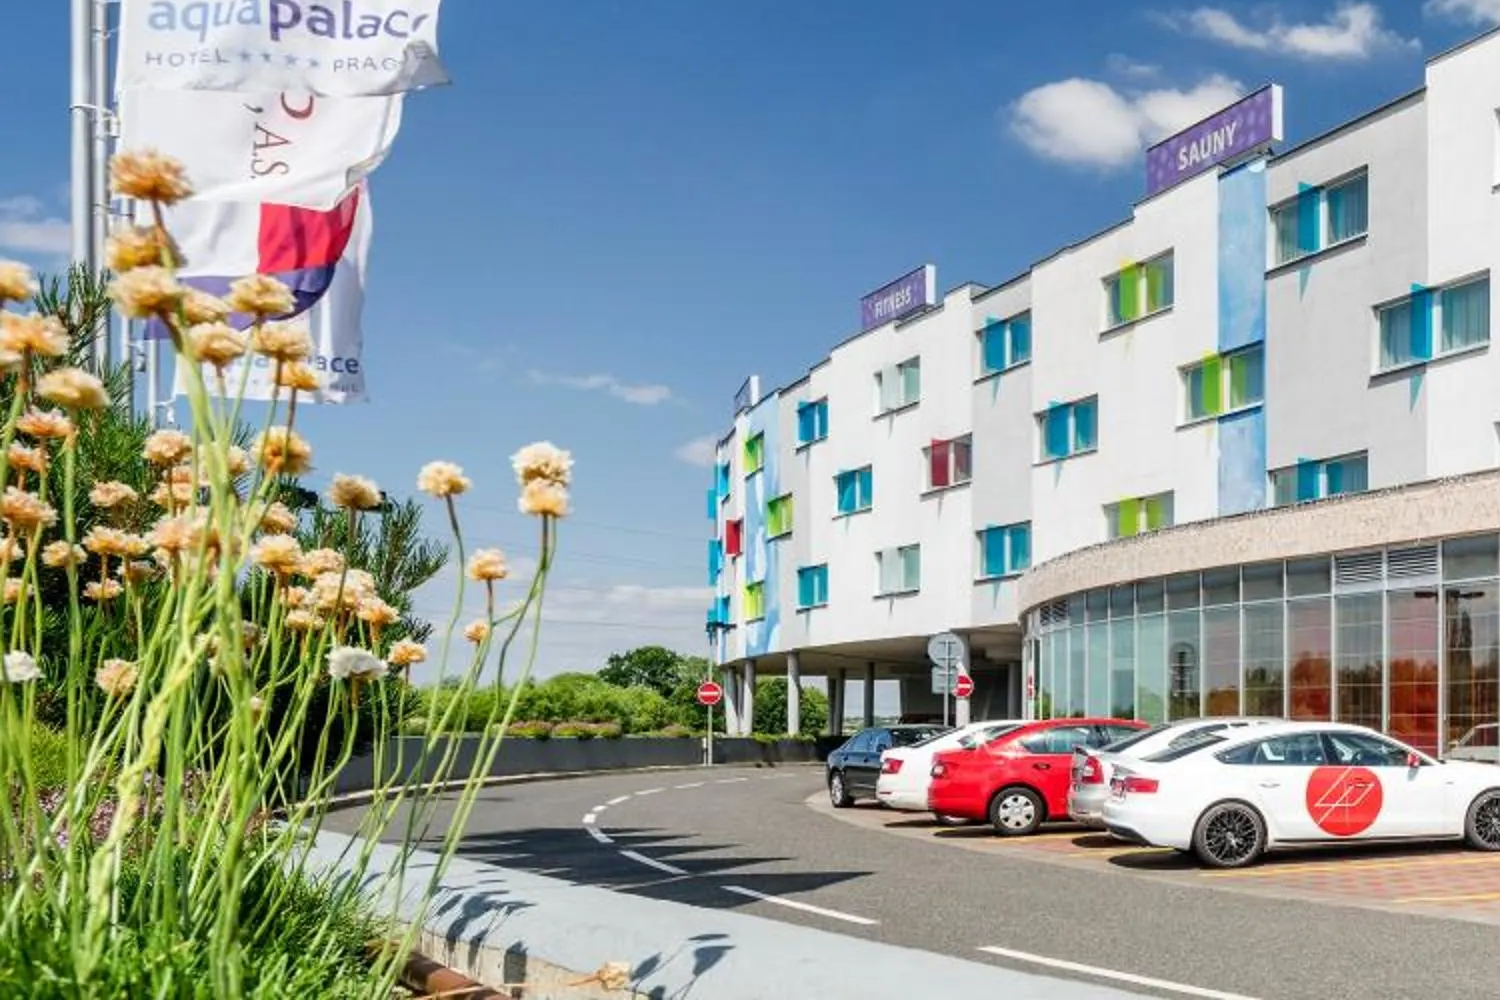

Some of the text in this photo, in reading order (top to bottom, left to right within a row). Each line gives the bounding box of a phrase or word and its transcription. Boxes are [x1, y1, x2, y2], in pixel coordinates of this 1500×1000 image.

[145, 48, 231, 67] HOTEL
[1177, 119, 1238, 171] SAUNY
[874, 285, 912, 320] FITNESS
